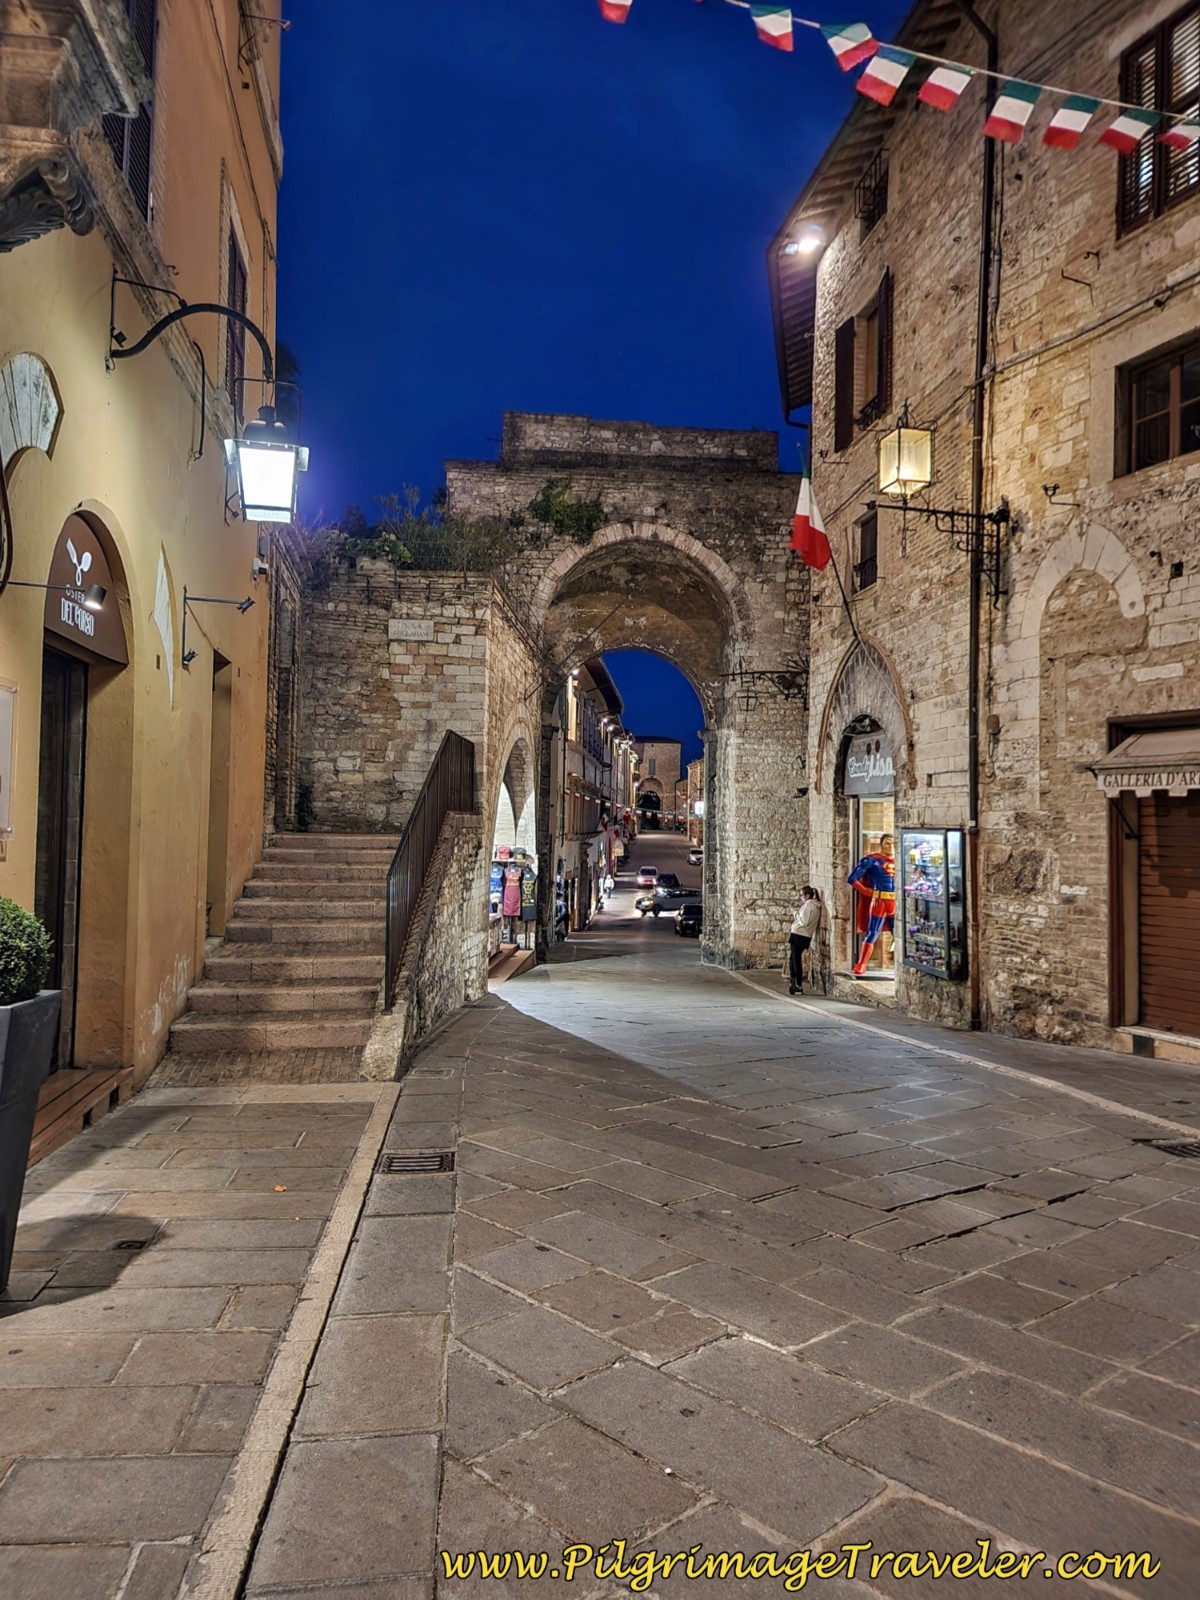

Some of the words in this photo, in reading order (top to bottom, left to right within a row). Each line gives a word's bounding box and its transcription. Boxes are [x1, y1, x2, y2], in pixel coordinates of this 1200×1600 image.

[61, 597, 74, 625] DEL
[75, 605, 94, 636] CORSO
[848, 756, 870, 782] Candy
[1104, 773, 1163, 787] GALLERIA
